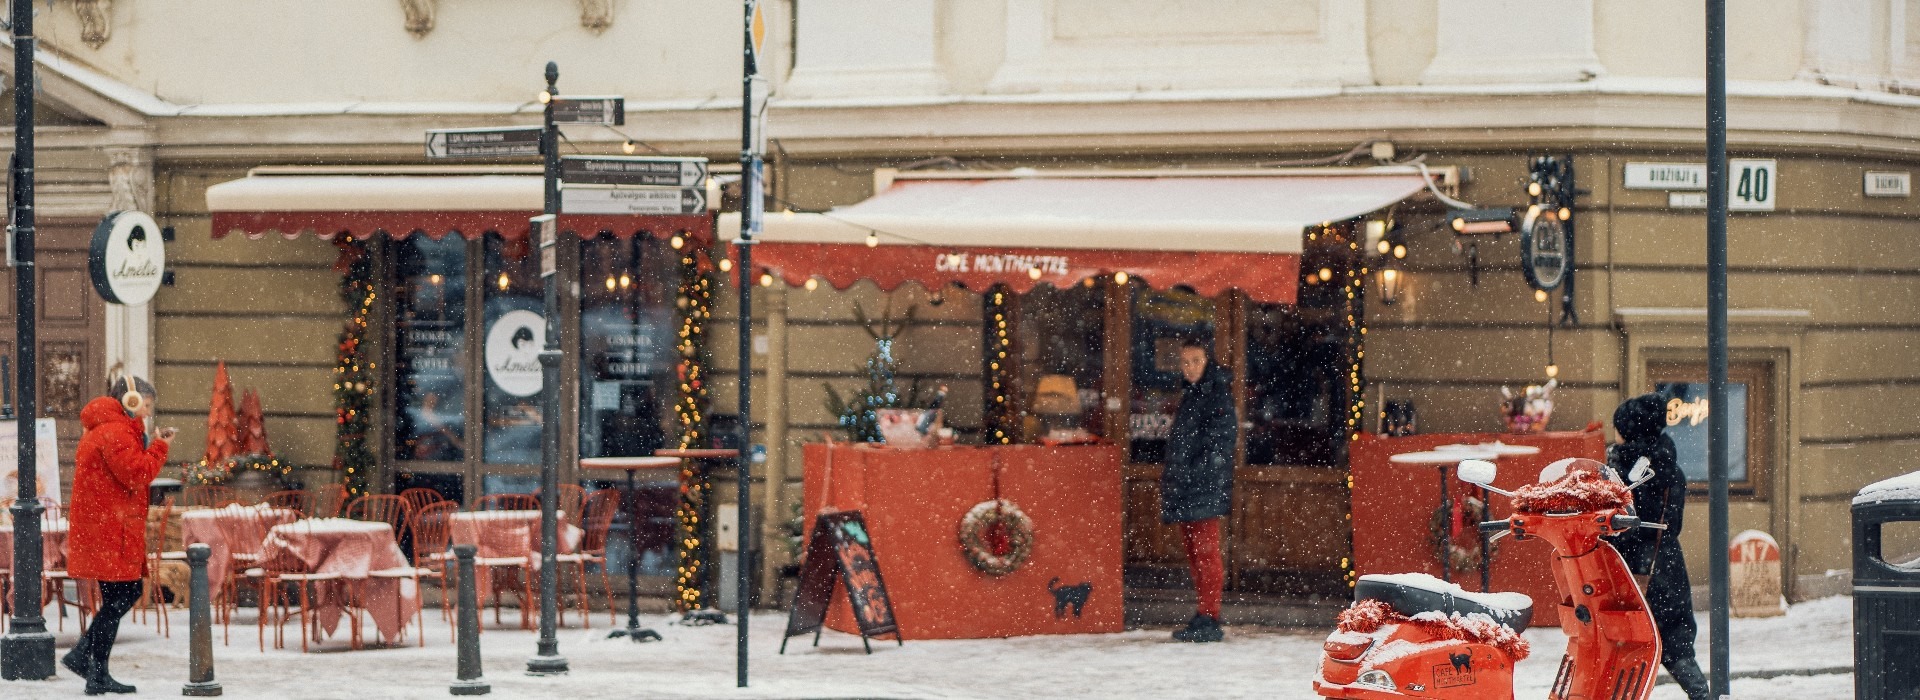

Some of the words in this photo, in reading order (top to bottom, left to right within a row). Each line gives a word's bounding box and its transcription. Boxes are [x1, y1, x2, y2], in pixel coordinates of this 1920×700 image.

[1737, 167, 1769, 202] 40
[411, 358, 448, 370] COFFEE
[609, 362, 647, 374] COFFEE
